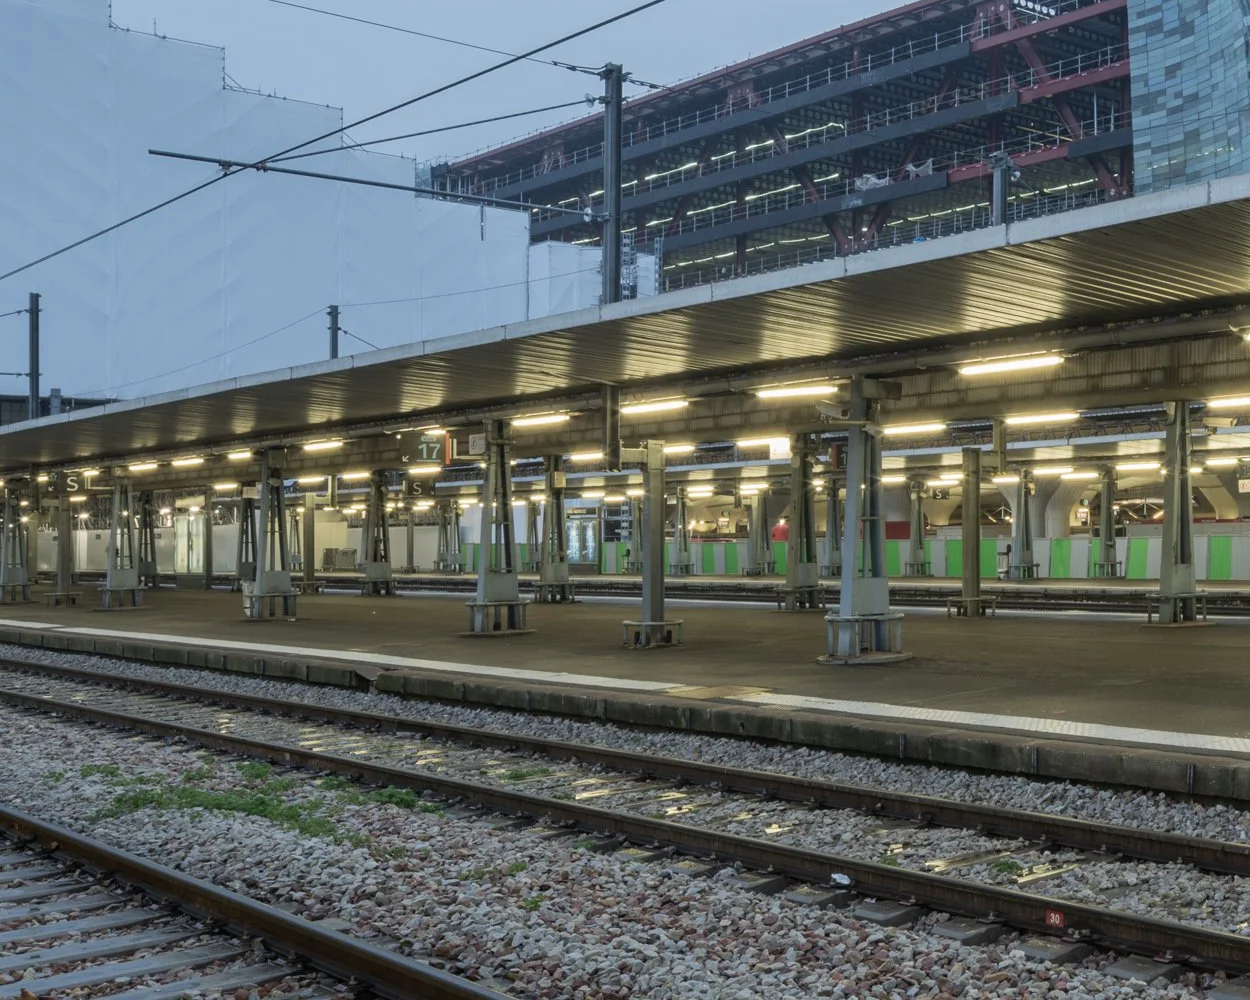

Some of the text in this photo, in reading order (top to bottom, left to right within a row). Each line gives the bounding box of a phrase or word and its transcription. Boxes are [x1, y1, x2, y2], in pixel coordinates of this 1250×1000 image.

[418, 443, 440, 459] 17
[66, 476, 79, 492] S
[413, 482, 422, 495] S
[935, 489, 942, 499] S
[1050, 913, 1060, 924] 30
